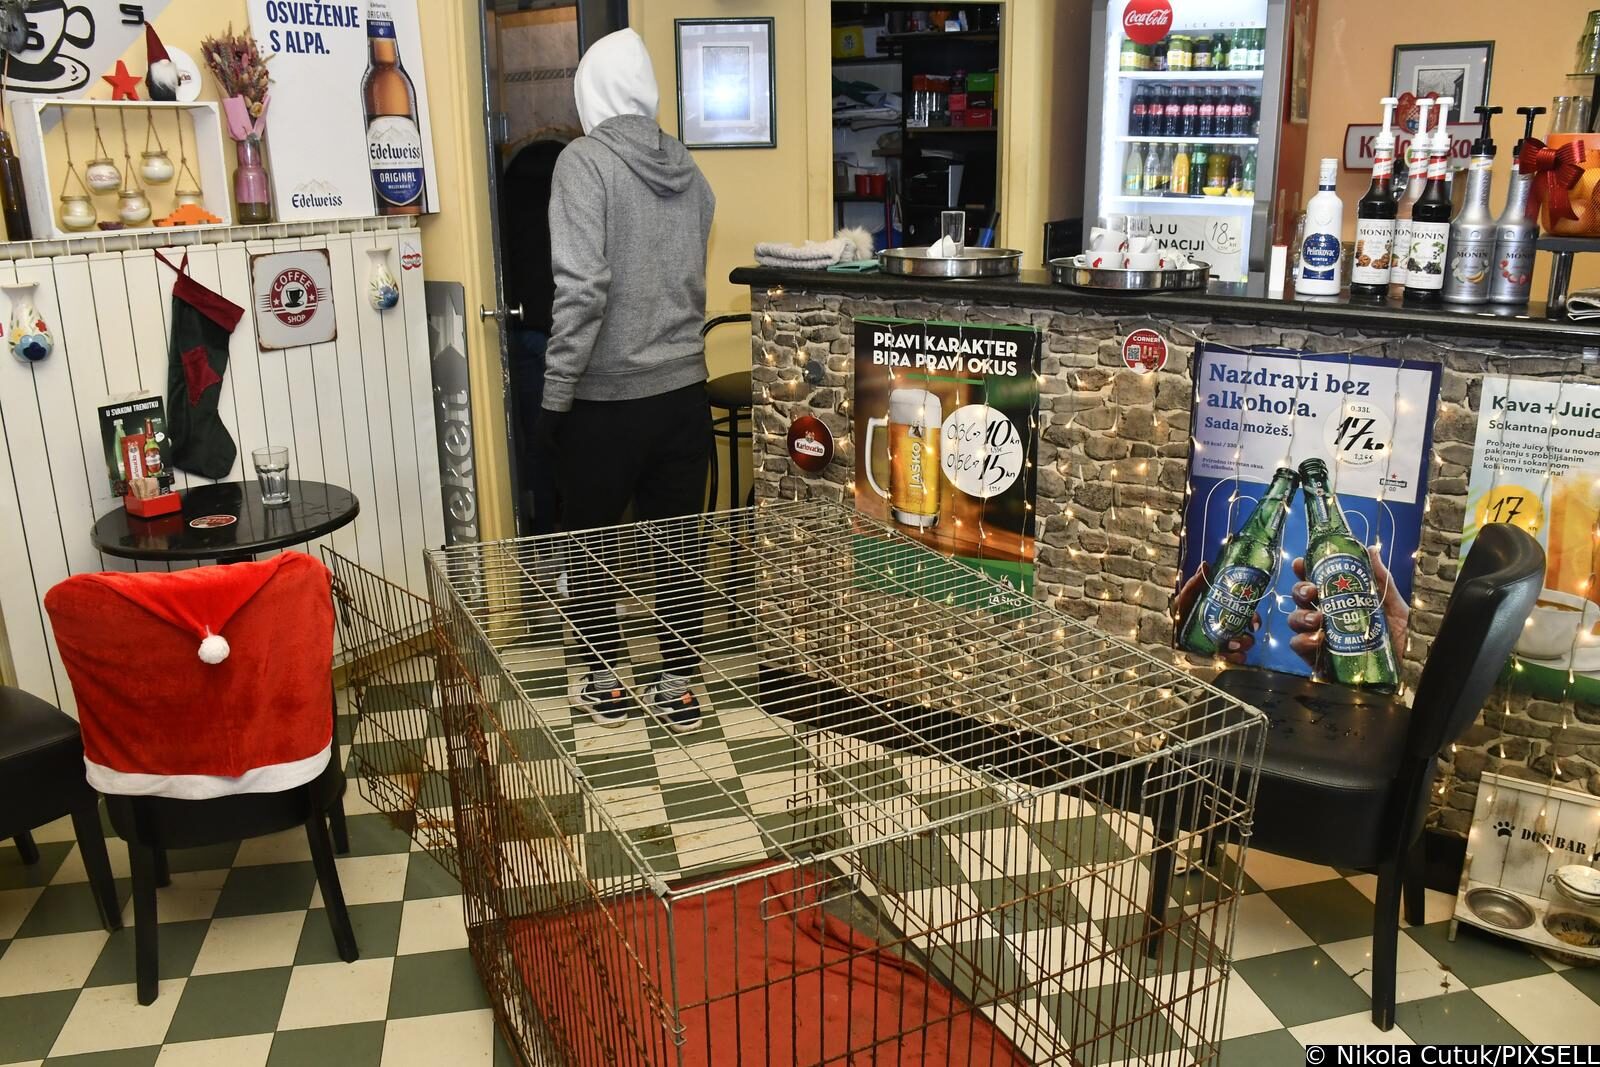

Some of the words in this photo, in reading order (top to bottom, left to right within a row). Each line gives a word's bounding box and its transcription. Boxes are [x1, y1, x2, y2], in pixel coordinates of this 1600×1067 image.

[266, 0, 360, 28] OSVJEŽENJE
[1125, 9, 1171, 26] Coca-Cola
[269, 30, 282, 53] S
[286, 31, 331, 54] ALPA.
[370, 143, 420, 160] Edelweiss
[380, 172, 417, 183] ORIGINAL
[292, 193, 343, 208] Edelweiss
[1168, 224, 1178, 235] U
[1155, 239, 1205, 251] NACIJI
[273, 271, 313, 293] COFFEE
[287, 314, 306, 324] SHOP
[873, 331, 921, 350] PRAVI
[924, 335, 1018, 358] KARAKTER
[873, 350, 910, 367] BIRA
[915, 354, 963, 372] PRAVI
[967, 357, 1018, 377] OKUS
[1209, 363, 1319, 391] Nazdravi
[1326, 373, 1370, 396] bez
[111, 406, 133, 416] SVAKOM
[133, 400, 159, 412] TRENUTKU
[1206, 390, 1317, 418] alkohola.
[1492, 395, 1541, 414] Kava
[984, 420, 1012, 447] 10
[1204, 416, 1239, 431] Sada
[1243, 421, 1293, 437] možeš.
[1489, 420, 1548, 434] Sokantna
[1551, 427, 1600, 439] ponuda
[1485, 448, 1524, 458] pakranju
[1522, 443, 1544, 452] Juicy
[979, 452, 1013, 486] 15
[1523, 459, 1570, 469] sokannom
[1525, 467, 1564, 477] vitamna!
[1492, 496, 1524, 524] 17
[1327, 628, 1343, 644] PURE
[1344, 635, 1365, 645] MALT
[1520, 828, 1552, 846] DOG
[1555, 836, 1587, 855] BAR
